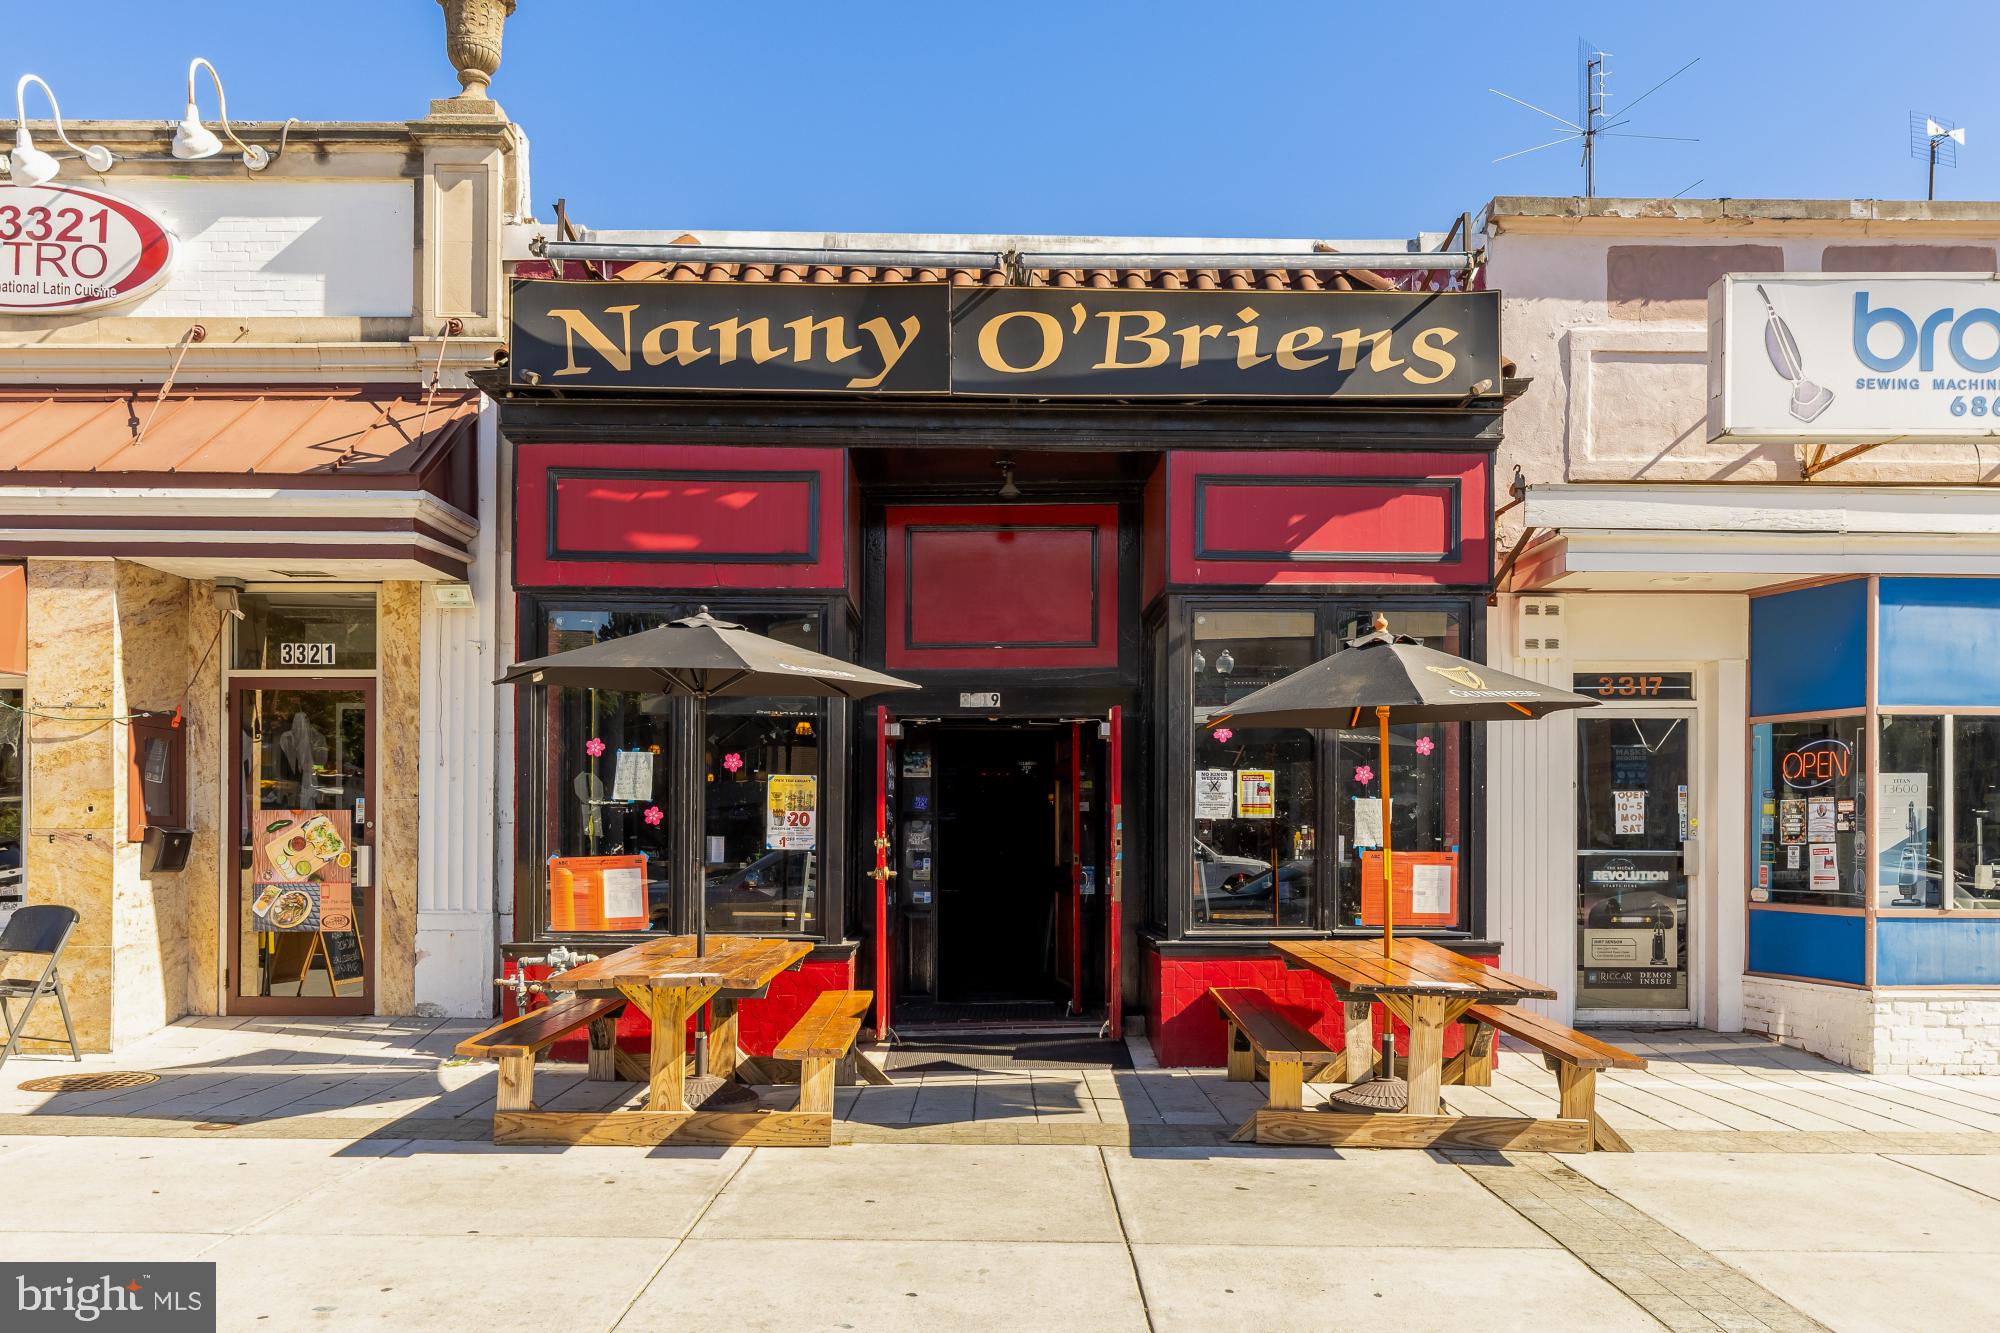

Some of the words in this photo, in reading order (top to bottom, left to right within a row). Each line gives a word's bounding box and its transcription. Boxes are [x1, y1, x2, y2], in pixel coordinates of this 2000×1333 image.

[0, 206, 108, 243] 3321
[0, 280, 39, 294] ational
[43, 281, 70, 295] Latin
[75, 283, 117, 298] Cuisine
[1854, 291, 2000, 373] bro
[547, 304, 921, 389] Nanny
[978, 302, 1459, 384] O'Briens
[1856, 378, 1920, 390] SEWING
[1932, 379, 2000, 391] MACHIN
[281, 643, 335, 664] 3321
[1599, 676, 1663, 695] 3317
[1782, 751, 1848, 779] OPEN
[787, 811, 810, 827] $20
[1622, 825, 1642, 833] SAT
[1592, 870, 1669, 881] REVOLUTION
[1600, 971, 1633, 981] RICCAR
[1640, 971, 1672, 979] DEMOS
